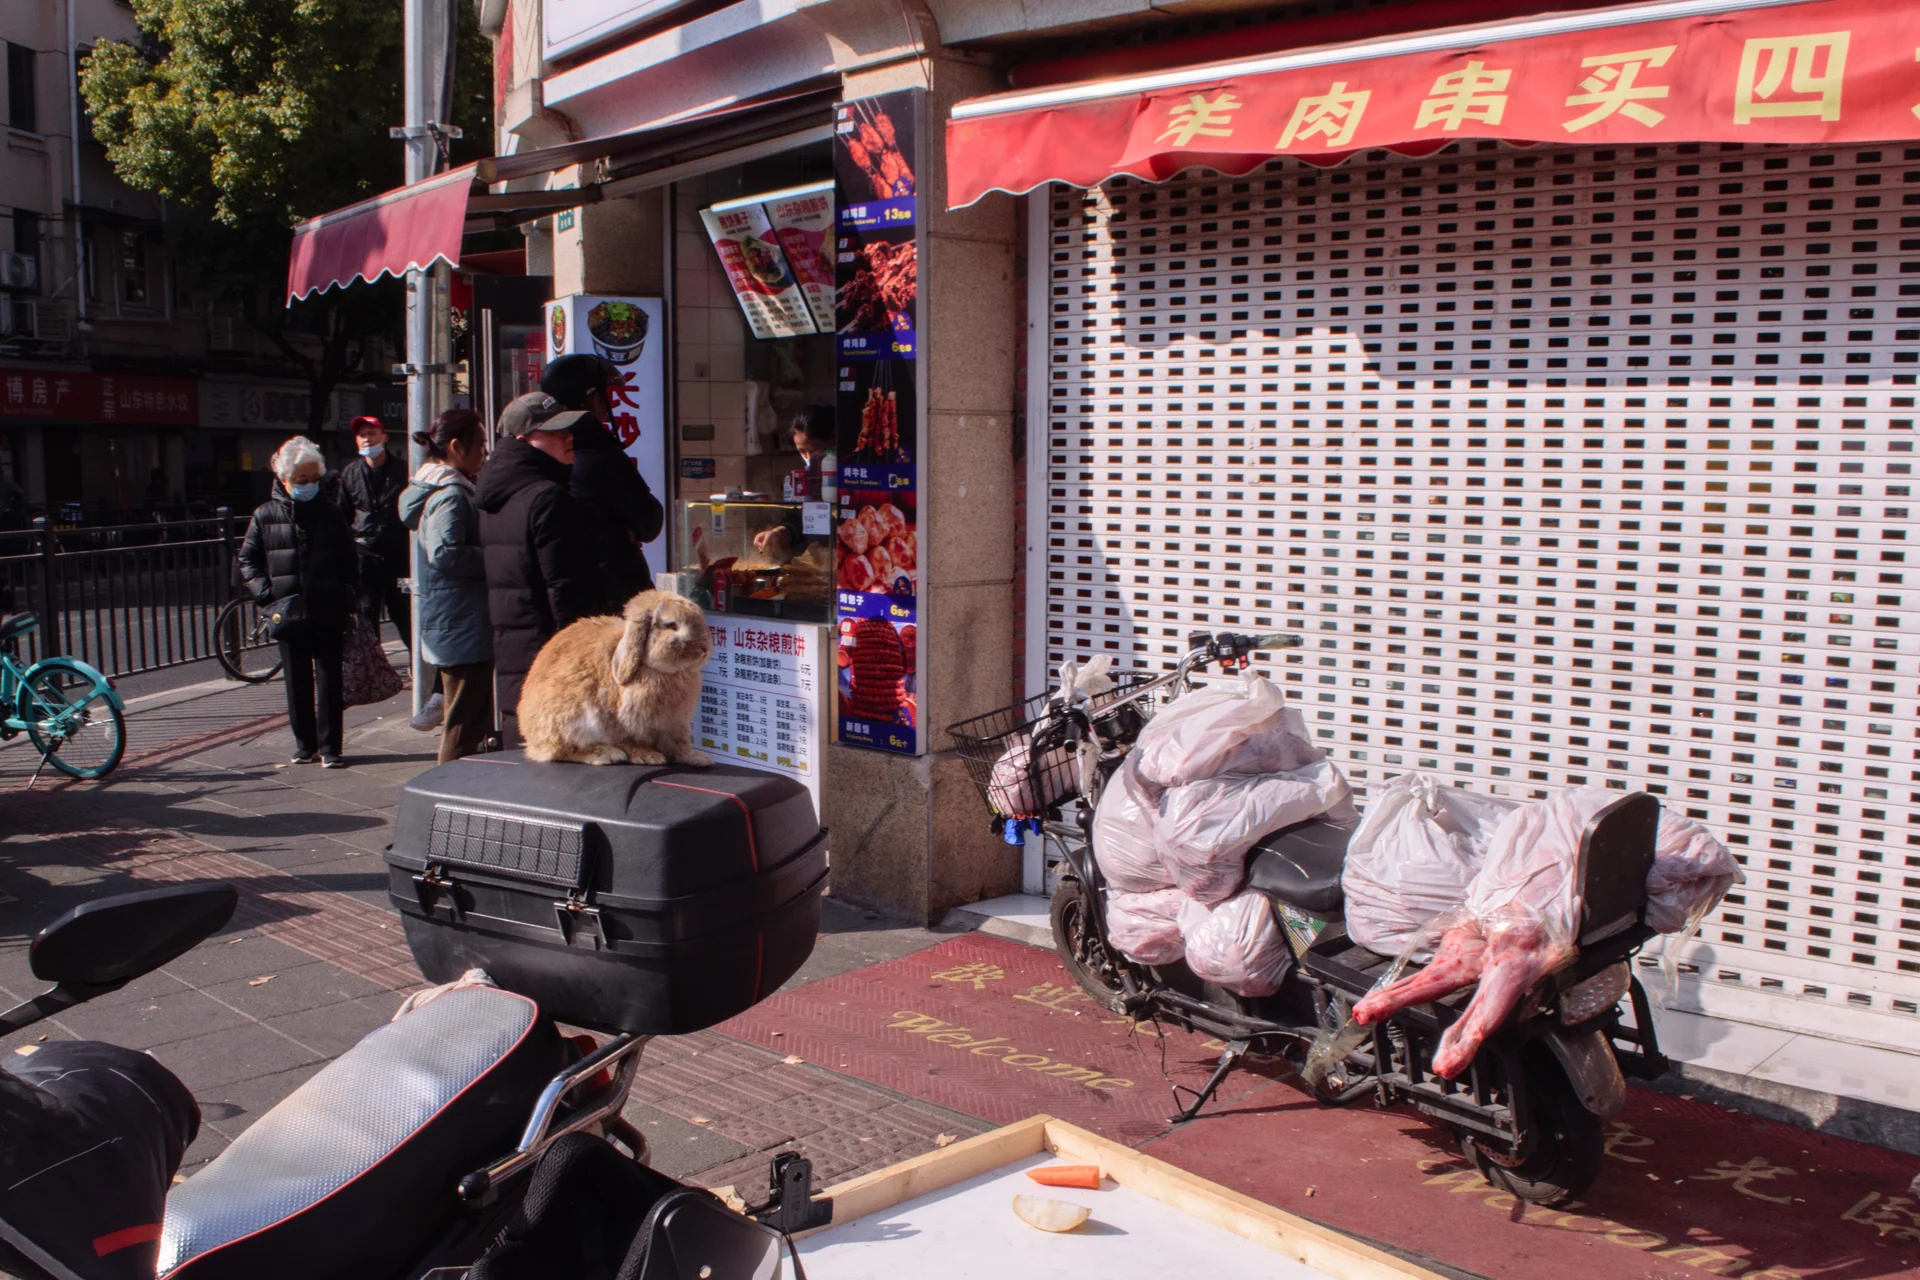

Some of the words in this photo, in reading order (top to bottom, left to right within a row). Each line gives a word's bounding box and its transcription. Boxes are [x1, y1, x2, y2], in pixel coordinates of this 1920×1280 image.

[1155, 30, 1920, 149] 羊肉串买四
[6, 374, 71, 405] 博房产
[102, 377, 116, 420] 正宗
[120, 389, 190, 412] 山东特色水饺
[734, 627, 805, 657] 山东杂粮煎饼
[801, 679, 811, 691] 7元
[887, 1010, 1135, 1091] Welcome
